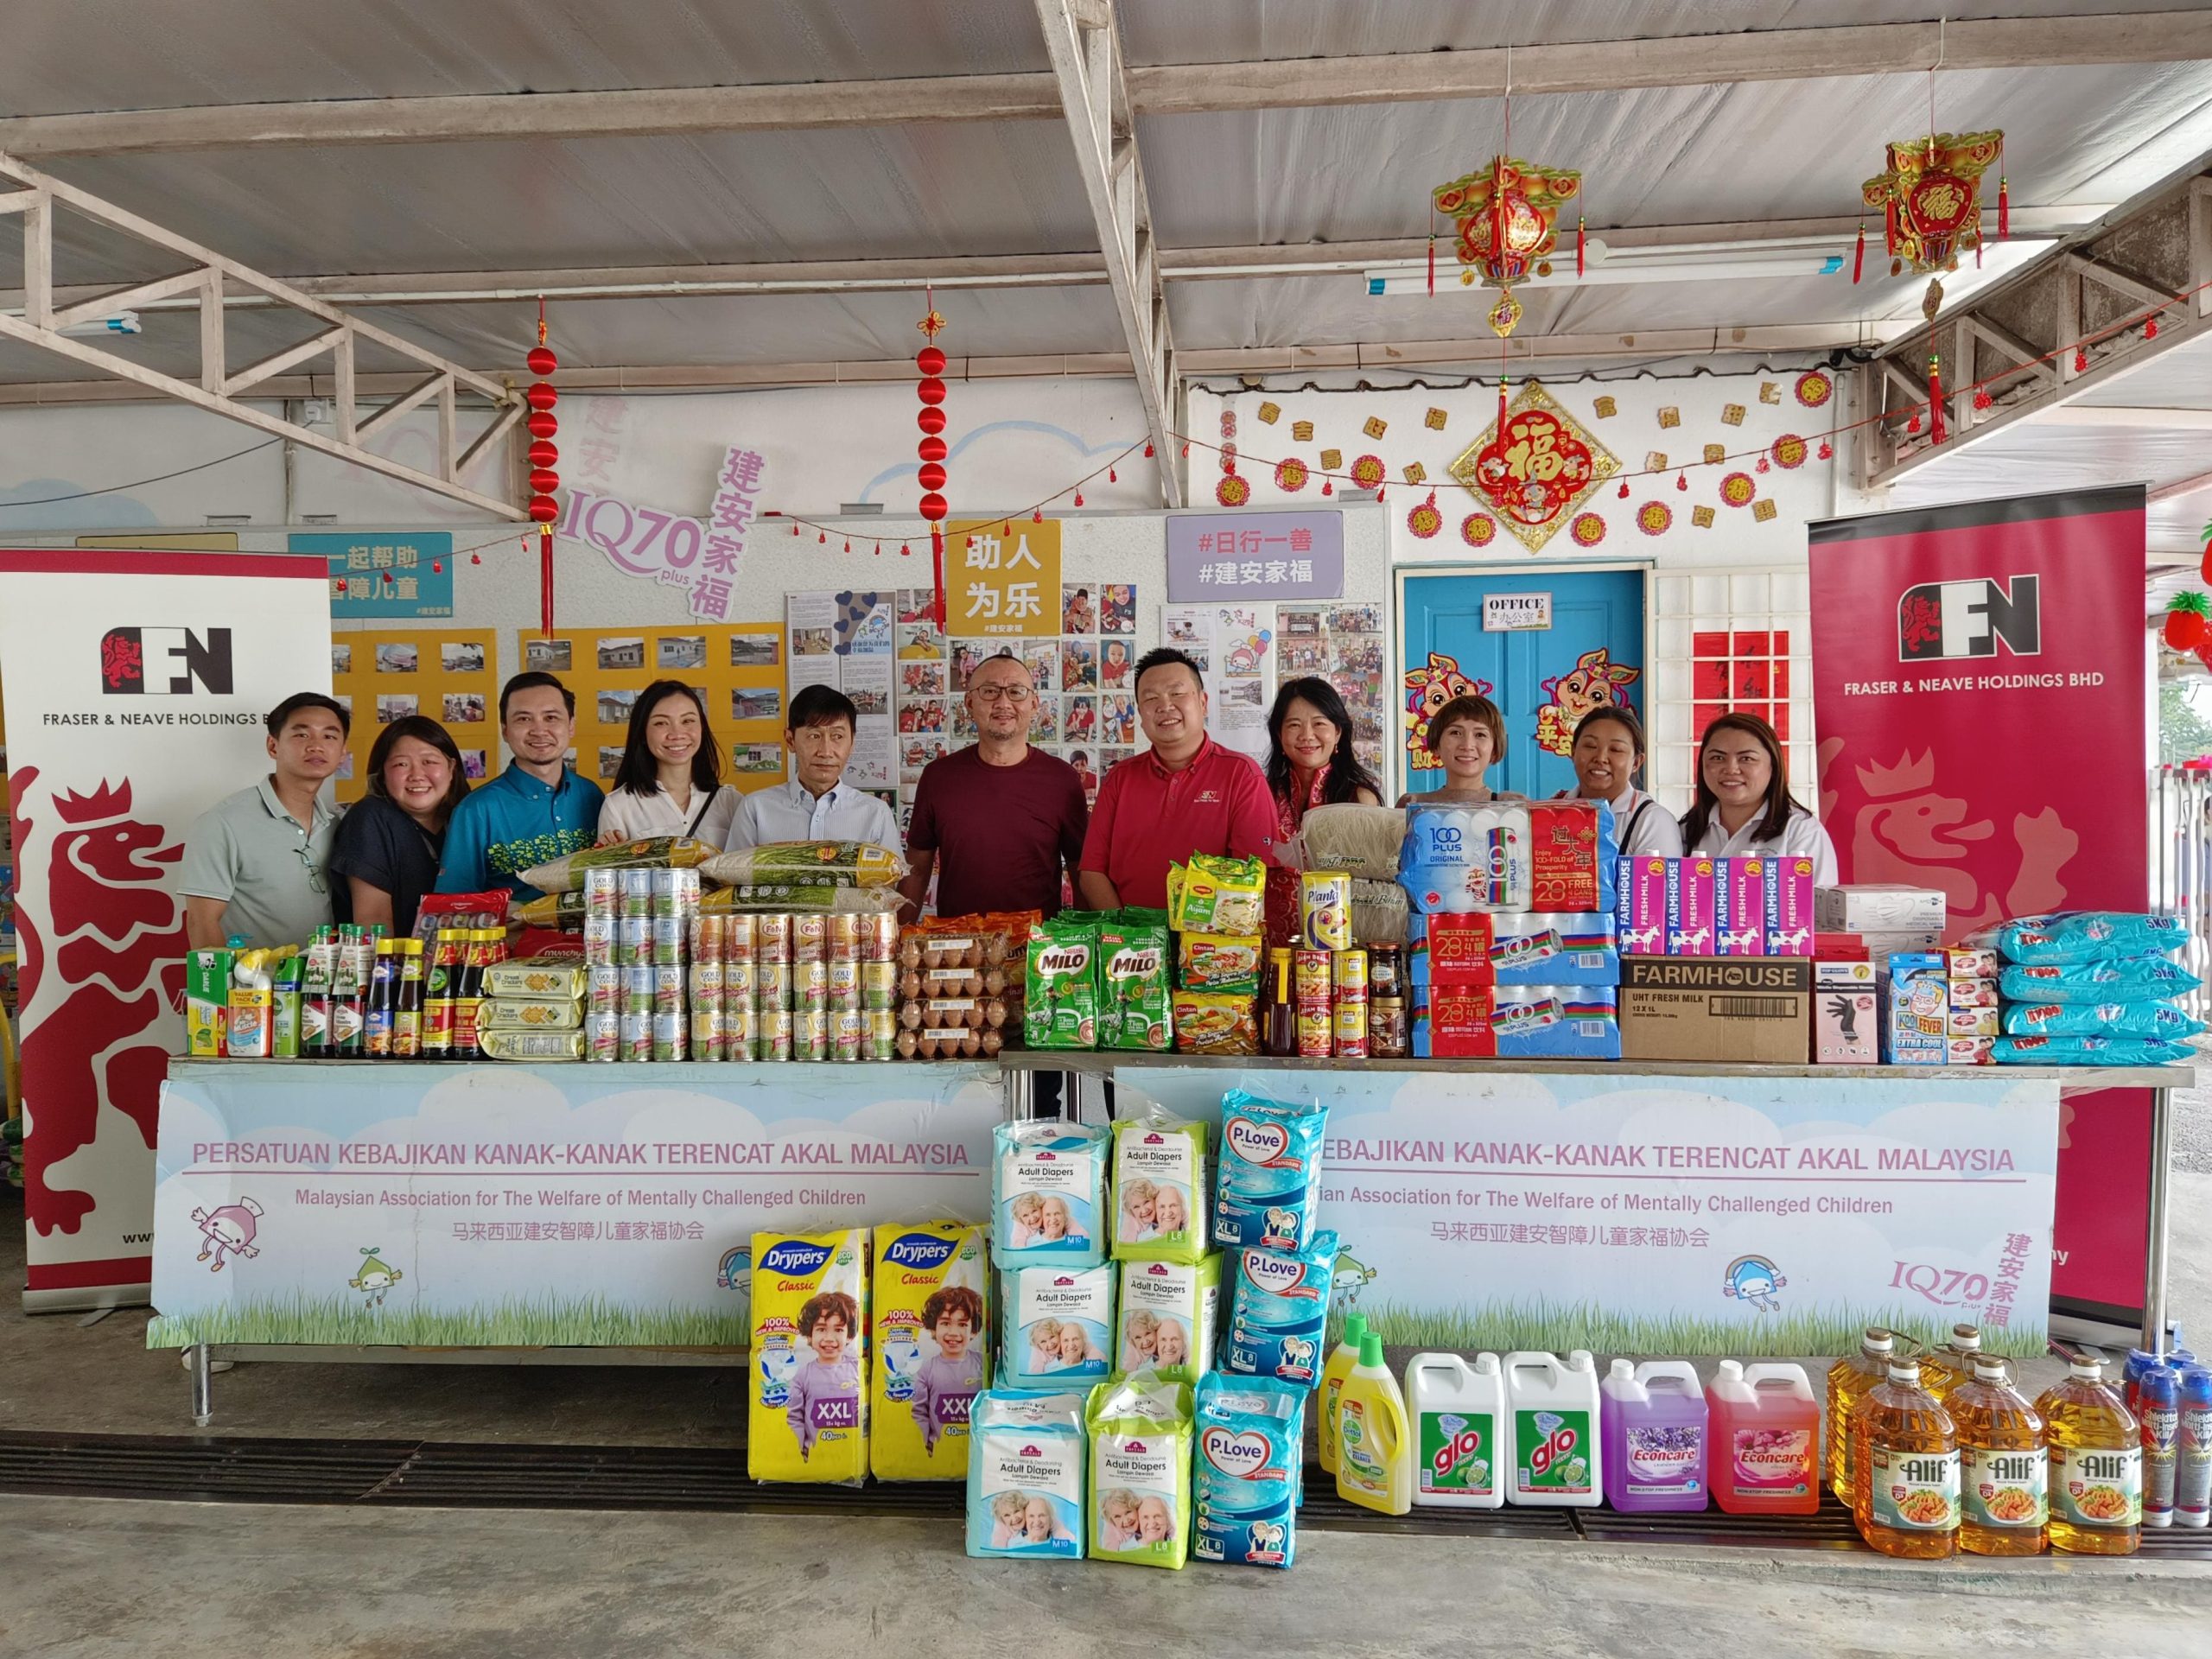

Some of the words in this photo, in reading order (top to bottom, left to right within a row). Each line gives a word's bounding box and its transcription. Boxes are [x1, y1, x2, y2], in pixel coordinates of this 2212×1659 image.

[1504, 422, 1565, 481] 福
[562, 489, 702, 575] IQ70
[692, 447, 765, 620] 建安家福
[1198, 528, 1313, 553] #日行一善
[965, 534, 1042, 570] 助人
[660, 569, 690, 585] plus
[1198, 560, 1313, 585] #建安家福
[965, 582, 1042, 618] 为乐
[1489, 598, 1544, 611] OFFICE
[1499, 611, 1535, 625] 办公室
[1844, 680, 1897, 696] FRASER
[1903, 680, 1913, 692] &
[1919, 677, 1973, 691] NEAVE
[1978, 673, 2063, 690] HOLDINGS
[2069, 672, 2104, 686] BHD
[43, 714, 99, 725] FRASER
[105, 715, 114, 725] &
[121, 714, 174, 725] NEAVE
[179, 713, 257, 725] HOLDINGS
[1430, 827, 1462, 844] 100
[1433, 843, 1462, 852] PLUS
[1535, 880, 1566, 902] 28
[1568, 880, 1593, 888] FREE
[1620, 860, 1630, 925] FARMHOUSE
[1669, 861, 1679, 927] FARMHOUSE
[1718, 861, 1727, 927] FARMHOUSE
[1767, 861, 1777, 927] FARMHOUSE
[1788, 876, 1796, 899] MILK
[1307, 889, 1340, 902] Planta
[1187, 905, 1211, 915] Ayam
[2145, 917, 2171, 929] 5Kg
[1436, 937, 1462, 957] 28
[1509, 955, 1528, 964] PLUS
[1633, 964, 1797, 987] FARMHOUSE
[1632, 994, 1650, 1002] UHT
[1652, 993, 1681, 1002] FRESH
[1683, 994, 1704, 1003] MILK
[1438, 1003, 1464, 1023] 28
[1897, 1013, 1917, 1028] KOOL
[2156, 1008, 2179, 1022] 5Kg
[1510, 1021, 1529, 1031] PLUS
[1918, 1017, 1942, 1034] FEVER
[1897, 1039, 1920, 1047] EXTRA
[1922, 1039, 1943, 1047] COOL
[1234, 1127, 1280, 1147] P.Love
[193, 1142, 330, 1164] PERSATUAN
[338, 1143, 467, 1165] KEBAJIKAN
[474, 1143, 646, 1165] KANAK-KANAK
[652, 1143, 775, 1165] TERENCAT
[780, 1143, 843, 1165] AKAL
[850, 1143, 969, 1166] MALAYSIA
[1127, 1152, 1148, 1160] Adult
[1150, 1152, 1182, 1161] Diapers
[1322, 1139, 1445, 1163] EBAJIKAN
[1453, 1141, 1645, 1167] KANAK-KANAK
[1652, 1145, 1790, 1169] TERENCAT
[1797, 1147, 1869, 1170] AKAL
[1877, 1147, 2015, 1172] MALAYSIA
[1042, 1168, 1074, 1177] Diapers
[296, 1189, 374, 1207] Malaysian
[379, 1189, 472, 1206] Association
[475, 1189, 499, 1206] for
[503, 1190, 533, 1206] The
[537, 1189, 601, 1206] Welfare
[607, 1190, 624, 1206] of
[627, 1190, 698, 1209] Mentally
[702, 1190, 794, 1209] Challenged
[798, 1189, 866, 1206] Children
[1350, 1186, 1451, 1205] Association
[1456, 1188, 1481, 1205] for
[1486, 1189, 1518, 1207] The
[1524, 1191, 1597, 1209] Welfare
[1600, 1192, 1618, 1210] of
[1624, 1193, 1702, 1214] Mentally
[1707, 1194, 1811, 1217] Challenged
[1816, 1196, 1893, 1214] Children
[452, 1221, 704, 1242] 马来西亚建安智障儿童家福协会
[1430, 1221, 1710, 1248] 马来西亚建安智障儿童家福协会
[767, 1249, 824, 1269] Drypers
[892, 1243, 949, 1263] Drypers
[1249, 1255, 1298, 1276] P.Love
[778, 1280, 815, 1293] Classic
[901, 1273, 939, 1286] Classic
[1131, 1281, 1151, 1291] Adult
[1154, 1283, 1185, 1294] Diapers
[1888, 1259, 1989, 1306] IQ70
[1982, 1232, 2033, 1328] 建安家福
[1060, 1294, 1091, 1303] Diapers
[765, 1318, 790, 1327] 100%
[888, 1310, 913, 1319] 100%
[817, 1402, 852, 1420] XXL
[1343, 1426, 1362, 1437] Dettol
[1211, 1438, 1262, 1459] P.Love
[1433, 1430, 1479, 1477] glo
[1531, 1428, 1577, 1476] glo
[1633, 1449, 1696, 1462] Econcare
[1740, 1451, 1805, 1464] Econcare
[1001, 1464, 1024, 1473] Adult
[1027, 1465, 1061, 1477] Diapers
[1105, 1459, 1129, 1469] Adult
[1131, 1461, 1166, 1471] Diapers
[1899, 1459, 1948, 1483] Alif
[1987, 1456, 2036, 1480] Alif
[2076, 1455, 2128, 1478] Alif
